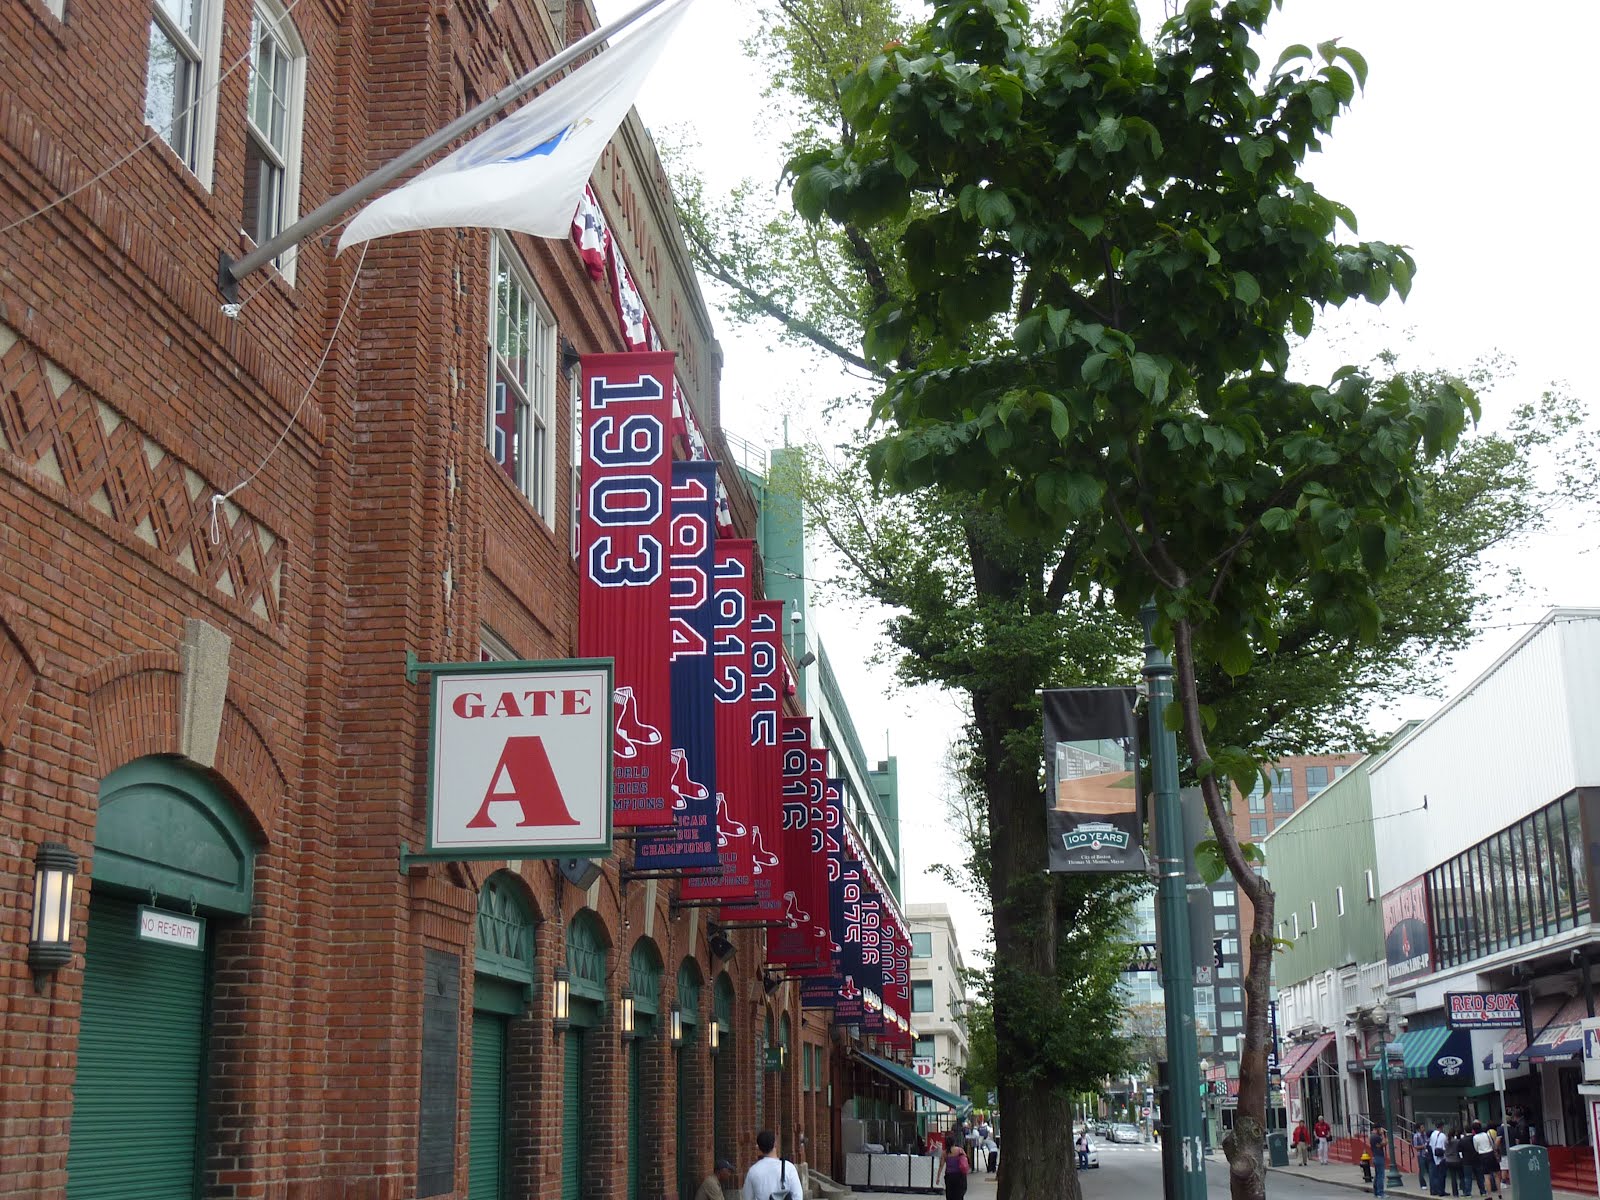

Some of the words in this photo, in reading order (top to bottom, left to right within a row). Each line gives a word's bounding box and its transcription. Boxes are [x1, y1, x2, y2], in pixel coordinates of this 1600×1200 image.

[589, 374, 664, 588] 1903
[452, 689, 592, 719] GATE
[465, 735, 581, 829] A
[613, 766, 650, 779] ORLD
[641, 842, 712, 856] CHAMPIONS
[1069, 834, 1087, 844] 100
[1089, 832, 1123, 843] YEARS
[843, 870, 861, 943] 1975
[142, 917, 155, 932] NO
[157, 920, 197, 940] RE-ENTRY
[861, 900, 880, 965] 1986
[1451, 995, 1484, 1012] RED
[1486, 993, 1519, 1011] SOX
[917, 1064, 931, 1076] D
